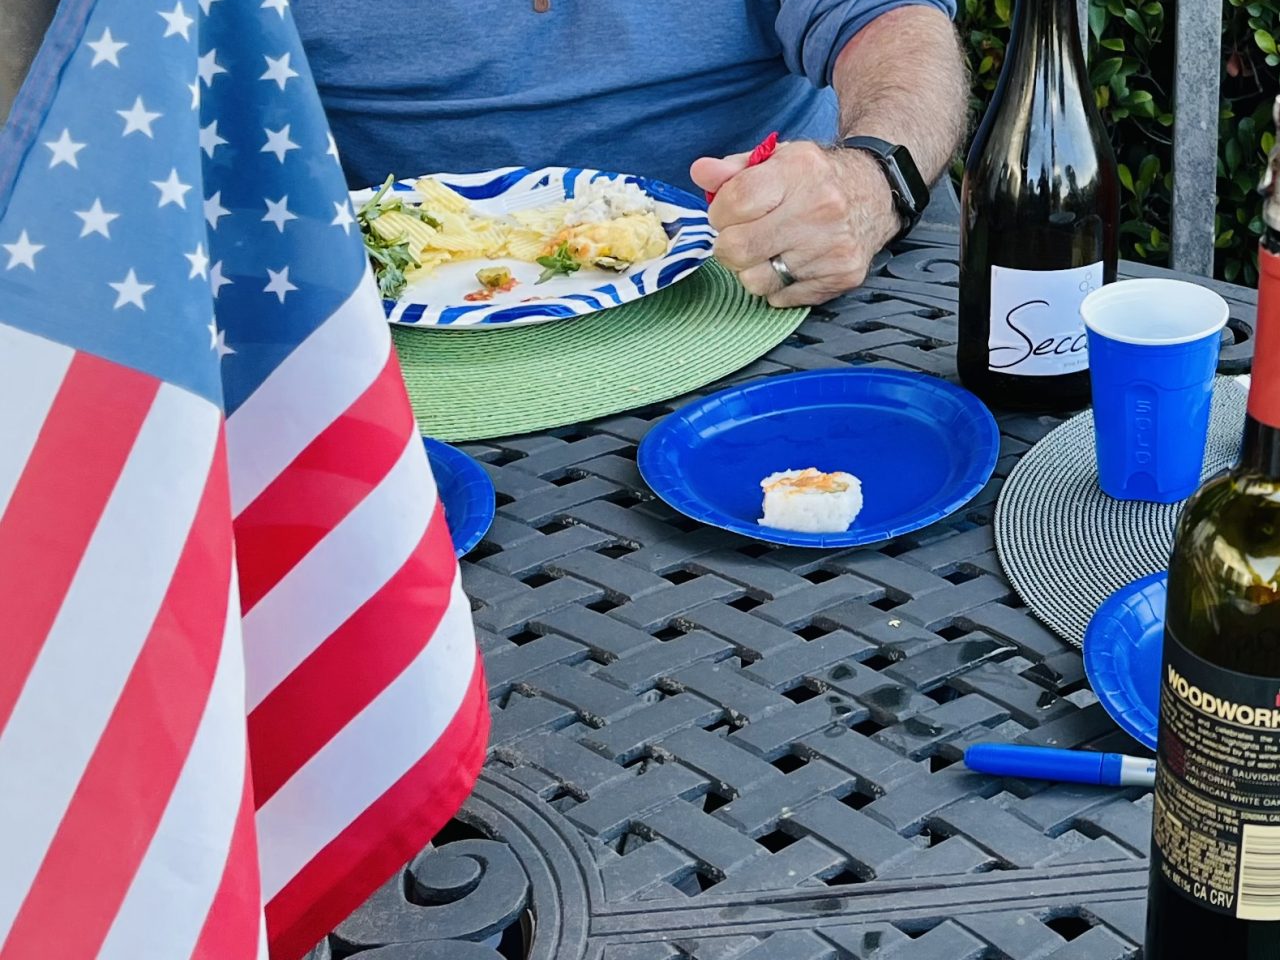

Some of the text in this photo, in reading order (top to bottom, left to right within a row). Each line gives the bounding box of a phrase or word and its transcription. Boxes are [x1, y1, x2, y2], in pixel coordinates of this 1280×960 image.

[988, 299, 1088, 369] Secc
[1185, 749, 1230, 775] CABERNET
[1185, 761, 1237, 789] CALIFORNIA
[1185, 774, 1228, 799] AMERICAN
[1229, 793, 1260, 807] WHITE
[1193, 882, 1208, 901] CA
[1210, 889, 1234, 909] CRV
